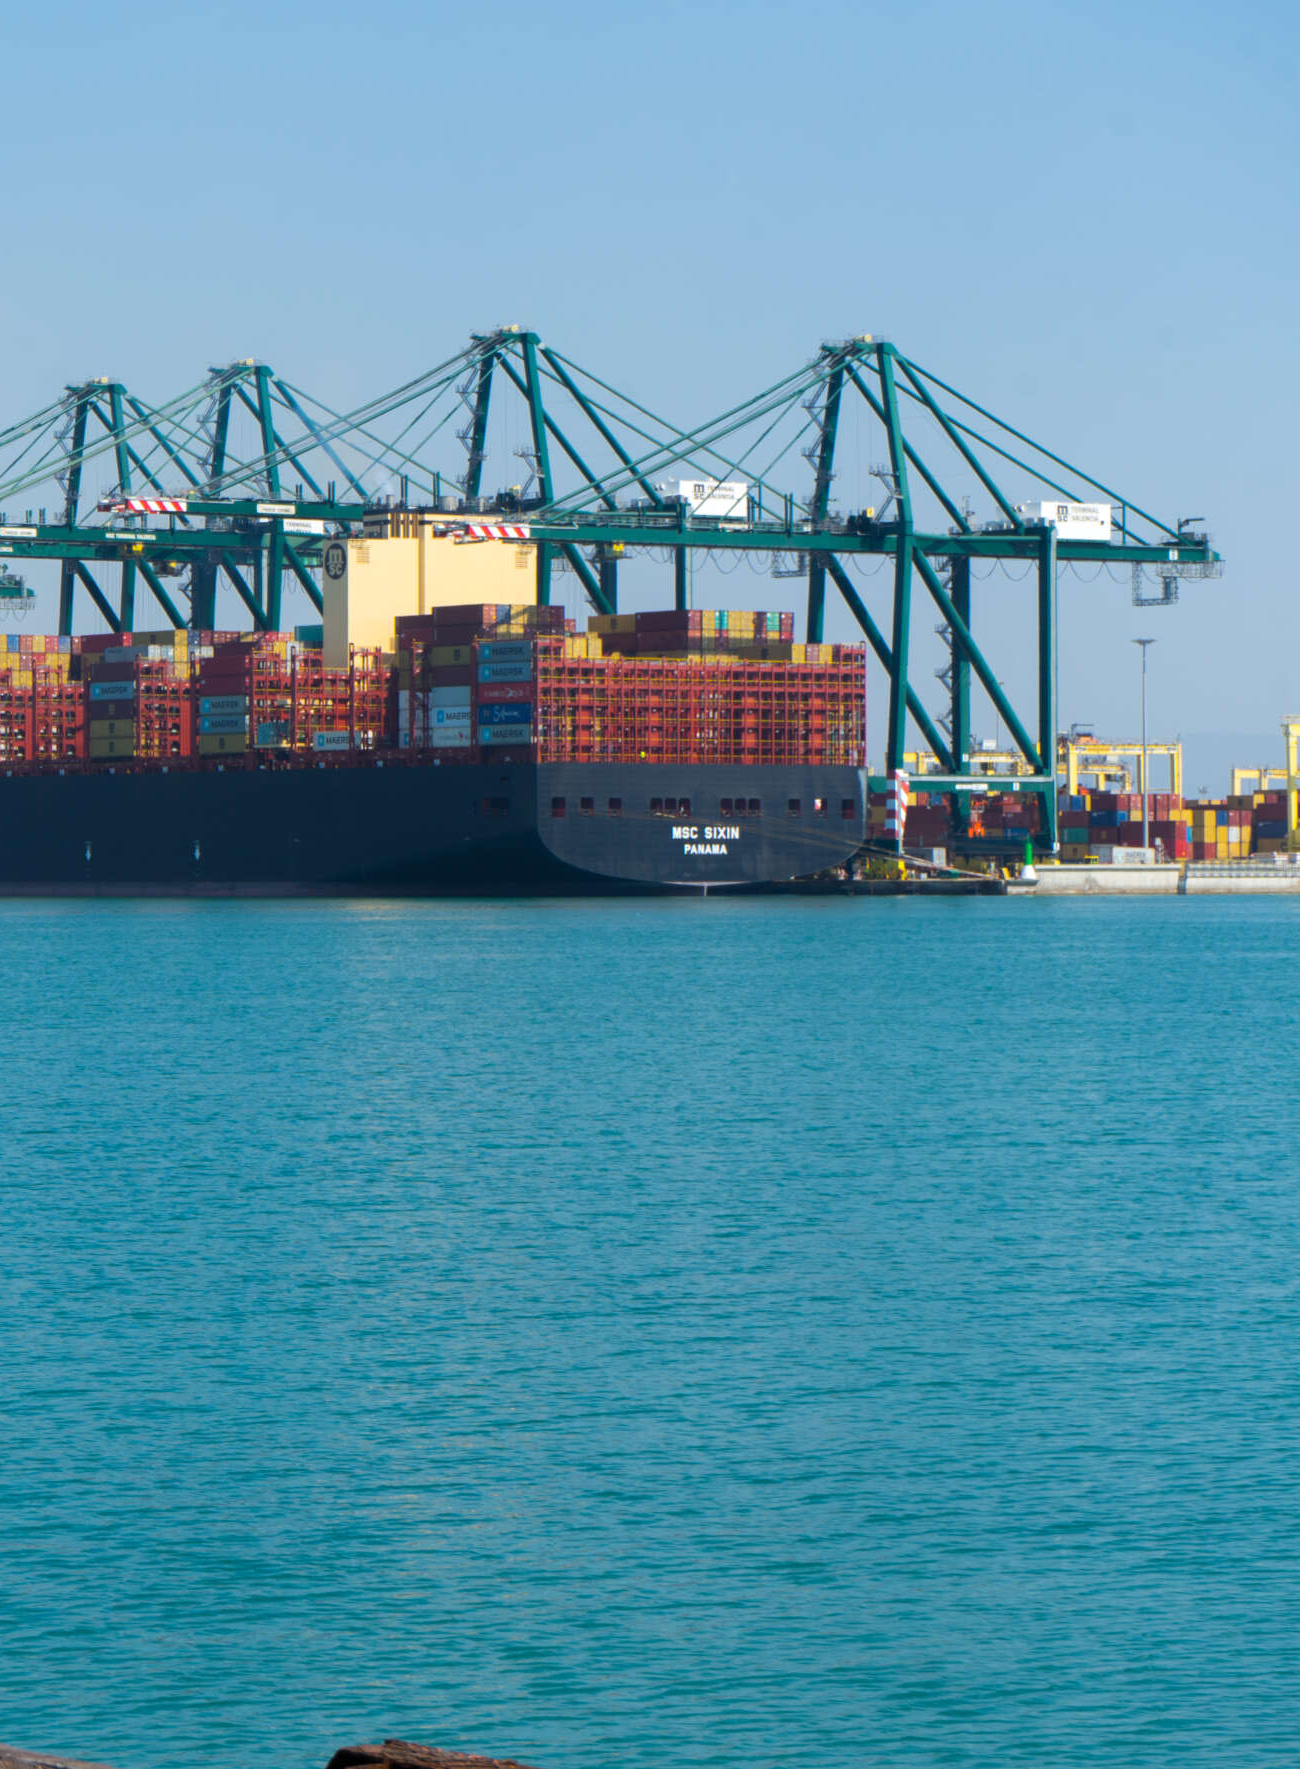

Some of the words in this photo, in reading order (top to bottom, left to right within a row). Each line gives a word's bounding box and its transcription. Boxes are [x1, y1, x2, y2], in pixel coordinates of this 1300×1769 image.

[672, 826, 698, 840] MSC
[704, 825, 740, 840] SIXIN
[684, 844, 728, 855] PANAMA
